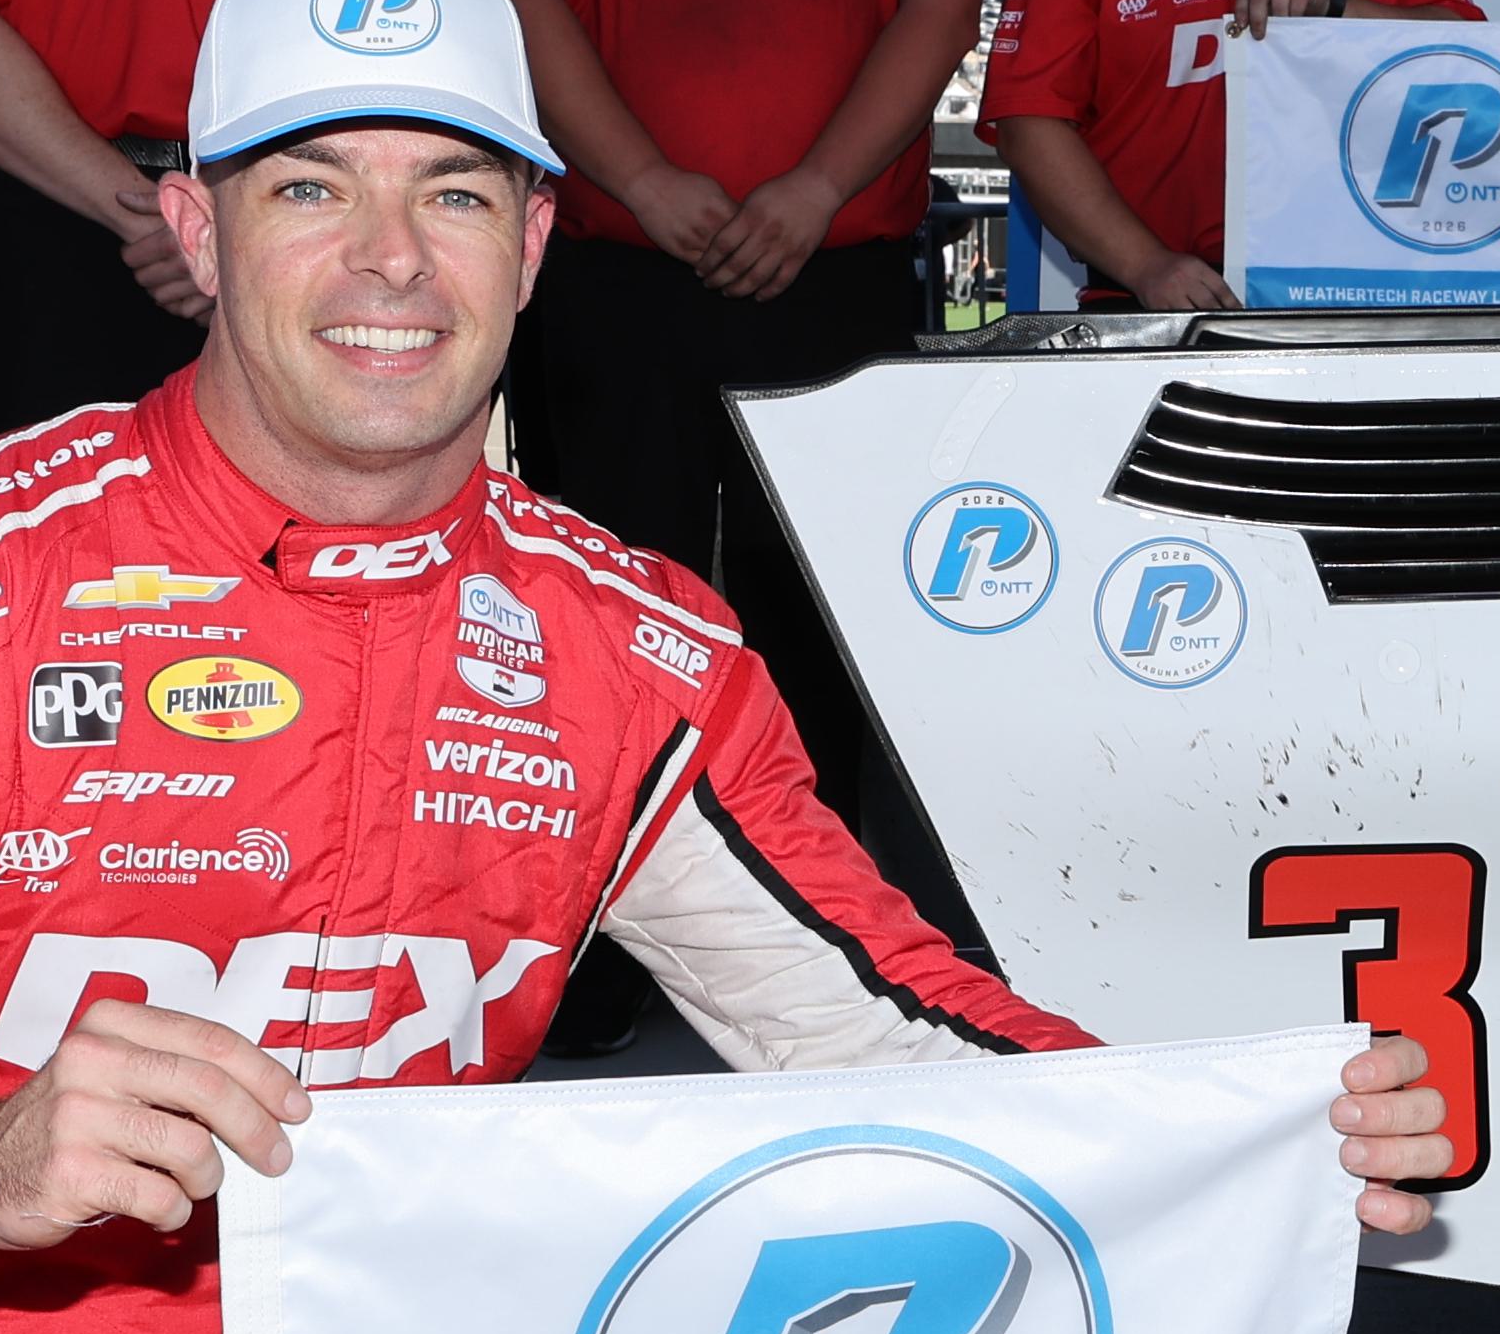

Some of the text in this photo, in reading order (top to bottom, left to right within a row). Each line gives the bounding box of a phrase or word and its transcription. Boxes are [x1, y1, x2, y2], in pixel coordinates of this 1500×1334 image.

[391, 20, 420, 32] NTT
[1421, 219, 1467, 233] 2026
[1288, 285, 1407, 304] WEATHERTECH
[1411, 287, 1488, 306] RACEWAY
[961, 494, 1006, 507] 2026
[309, 518, 462, 579] DEX
[1149, 549, 1192, 562] 2026
[999, 581, 1034, 595] NTT
[492, 605, 527, 632] NTT
[457, 622, 544, 665] INDYCAR
[634, 624, 711, 677] OMP
[1188, 635, 1221, 649] NTT
[476, 646, 525, 670] SERIES
[1135, 658, 1213, 677] LAGUNA SECA
[35, 672, 123, 738] PPG
[166, 680, 281, 715] PENNZOIL
[435, 705, 560, 743] MCLAUGHLIN
[424, 739, 576, 792] verizon
[413, 790, 576, 839] HITACHI
[100, 840, 266, 873] Clarience
[100, 872, 197, 884] TECHNOLOGIES
[1248, 842, 1491, 1193] 3
